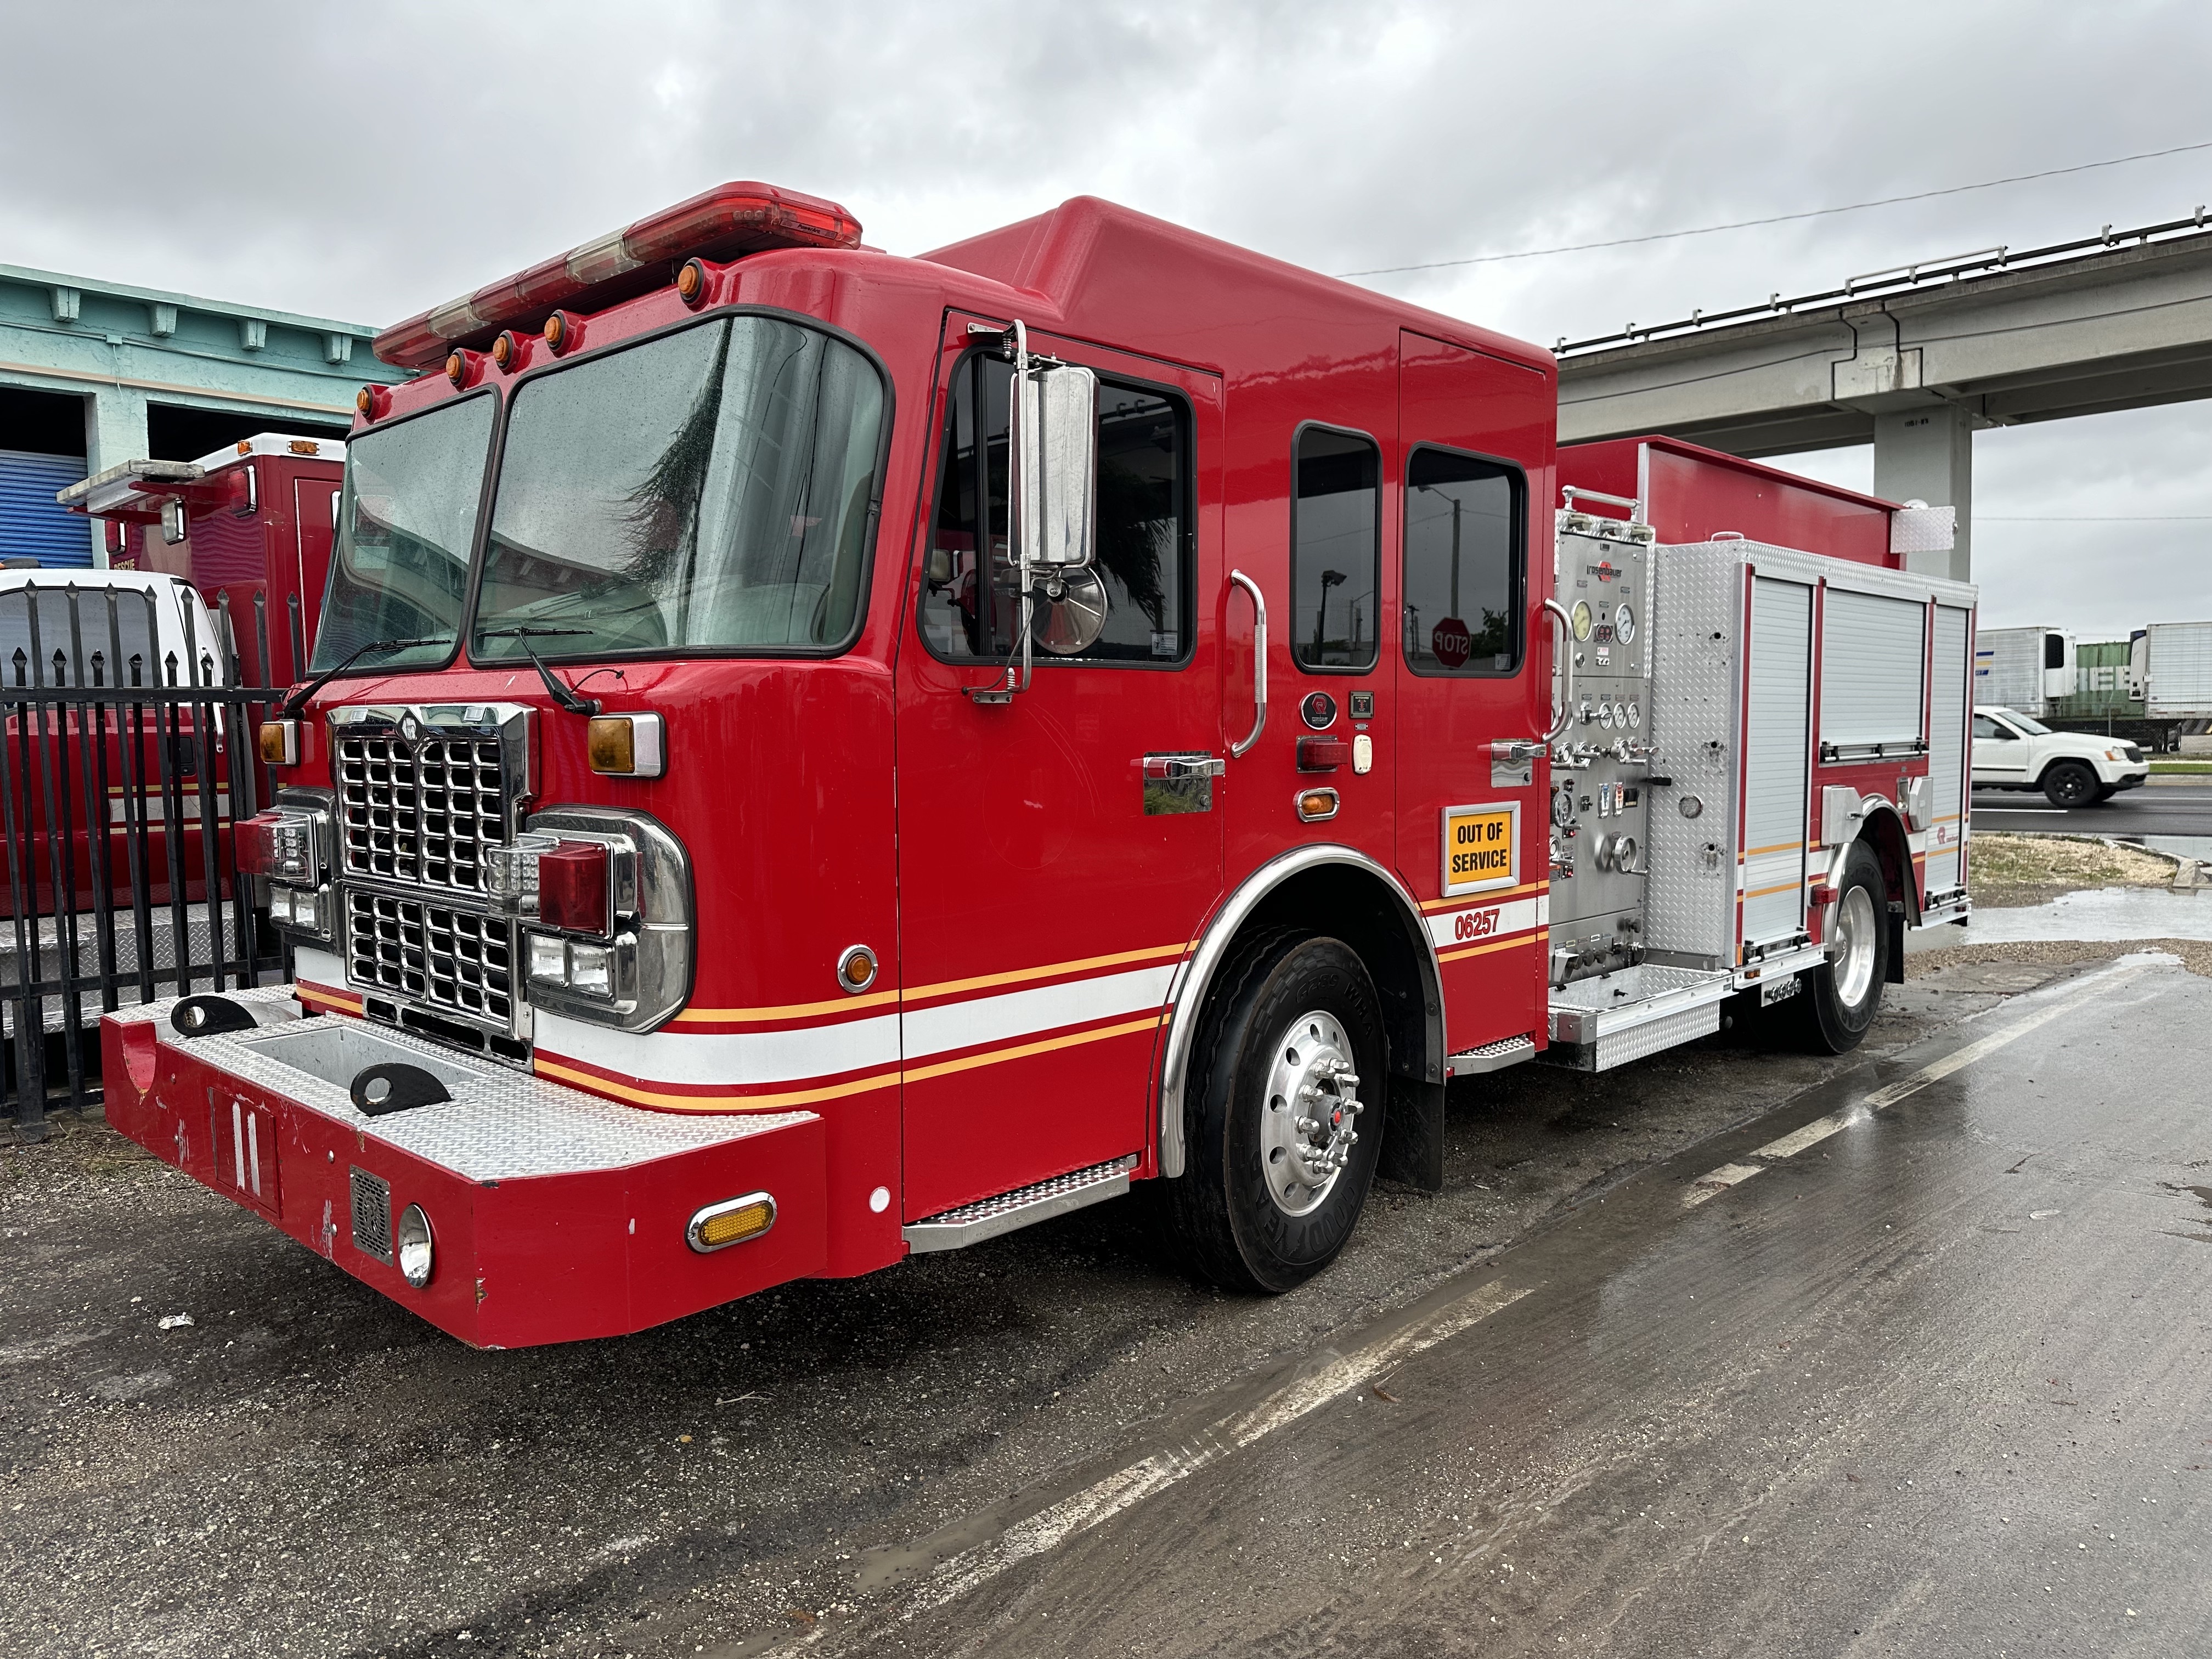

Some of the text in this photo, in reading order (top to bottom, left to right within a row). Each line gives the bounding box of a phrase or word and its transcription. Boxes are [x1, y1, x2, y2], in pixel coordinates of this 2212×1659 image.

[1458, 822, 1503, 844] OUT OF
[1452, 849, 1507, 873] SERVICE
[1455, 908, 1500, 940] 06257
[1250, 1150, 1358, 1259] GOODYEAR
